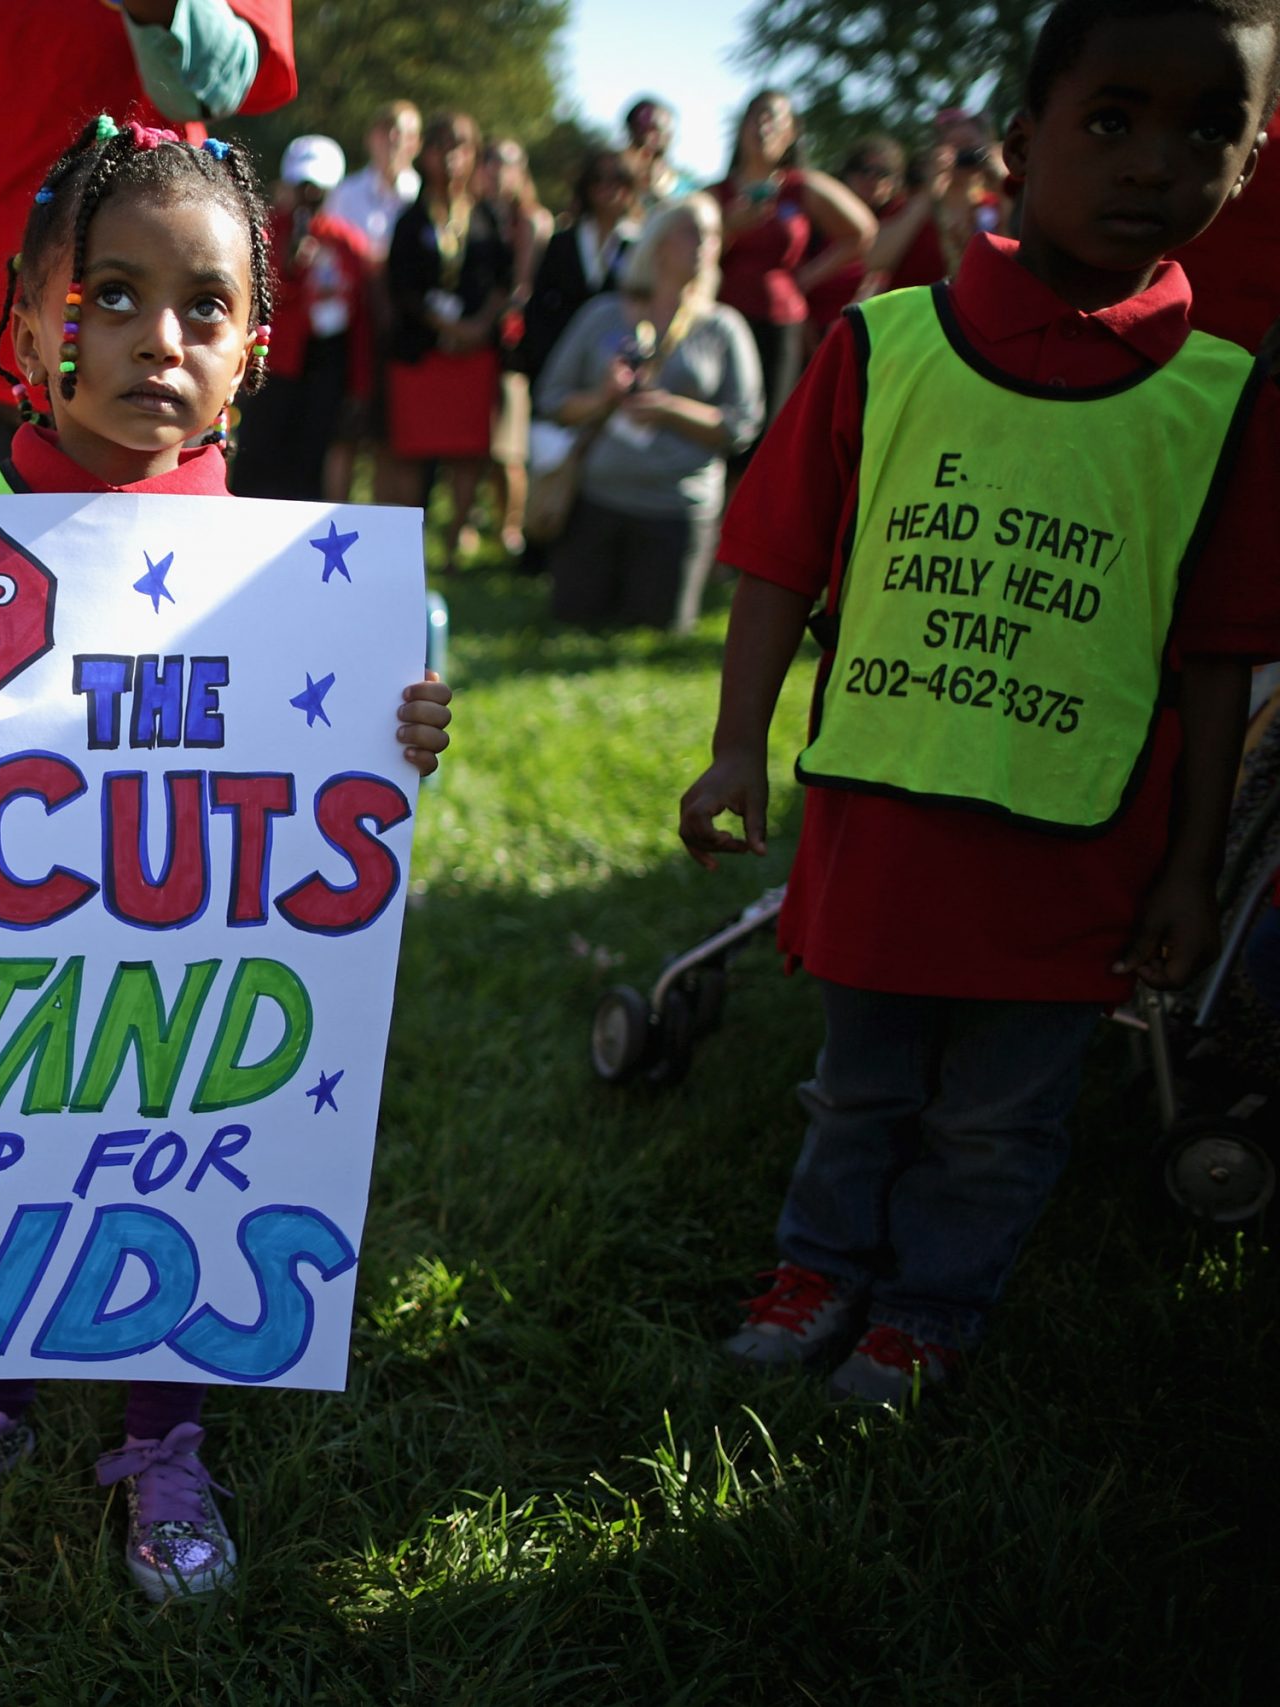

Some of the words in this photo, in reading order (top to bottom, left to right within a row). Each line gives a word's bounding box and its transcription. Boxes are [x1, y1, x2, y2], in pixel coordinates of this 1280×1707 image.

[886, 502, 980, 543] HEAD
[883, 554, 993, 597] EARLY
[1003, 563, 1100, 624] HEAD
[923, 609, 1031, 661] START
[72, 653, 230, 750] THE
[73, 1124, 251, 1199] FOR
